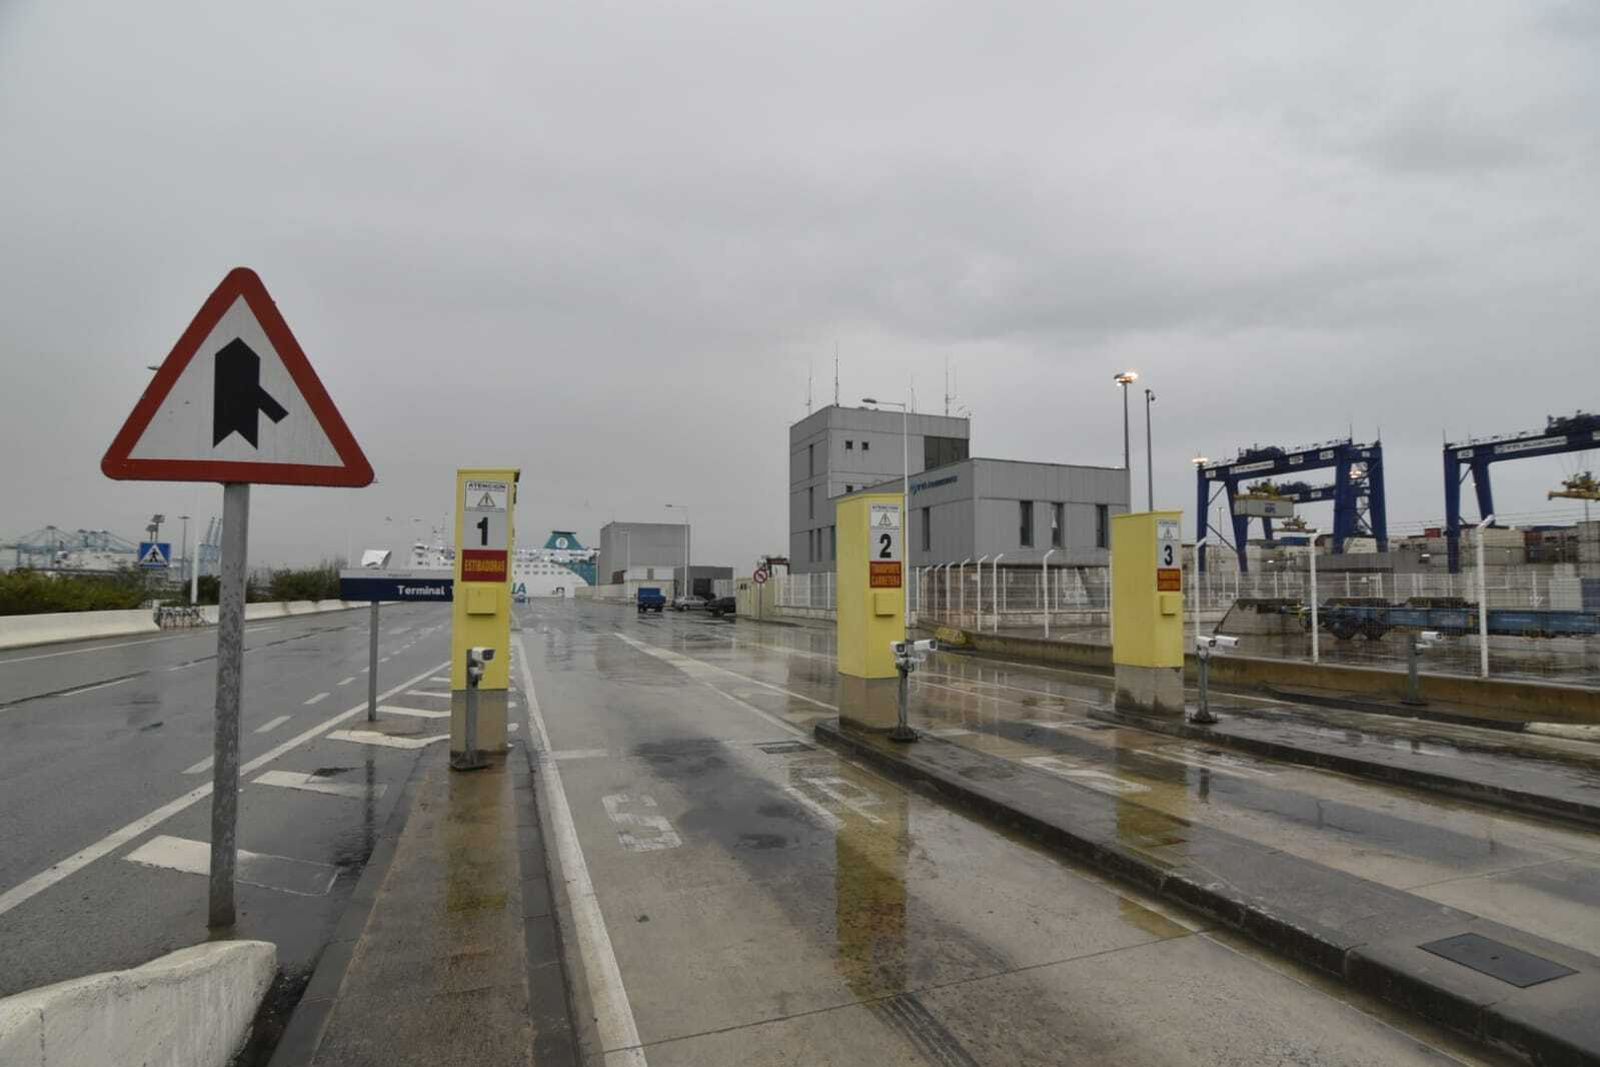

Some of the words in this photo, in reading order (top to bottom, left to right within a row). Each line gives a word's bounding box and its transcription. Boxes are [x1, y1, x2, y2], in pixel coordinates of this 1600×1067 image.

[477, 516, 489, 546] 1
[879, 533, 892, 559] 2
[1164, 544, 1173, 567] 3
[397, 585, 445, 596] Terminal
